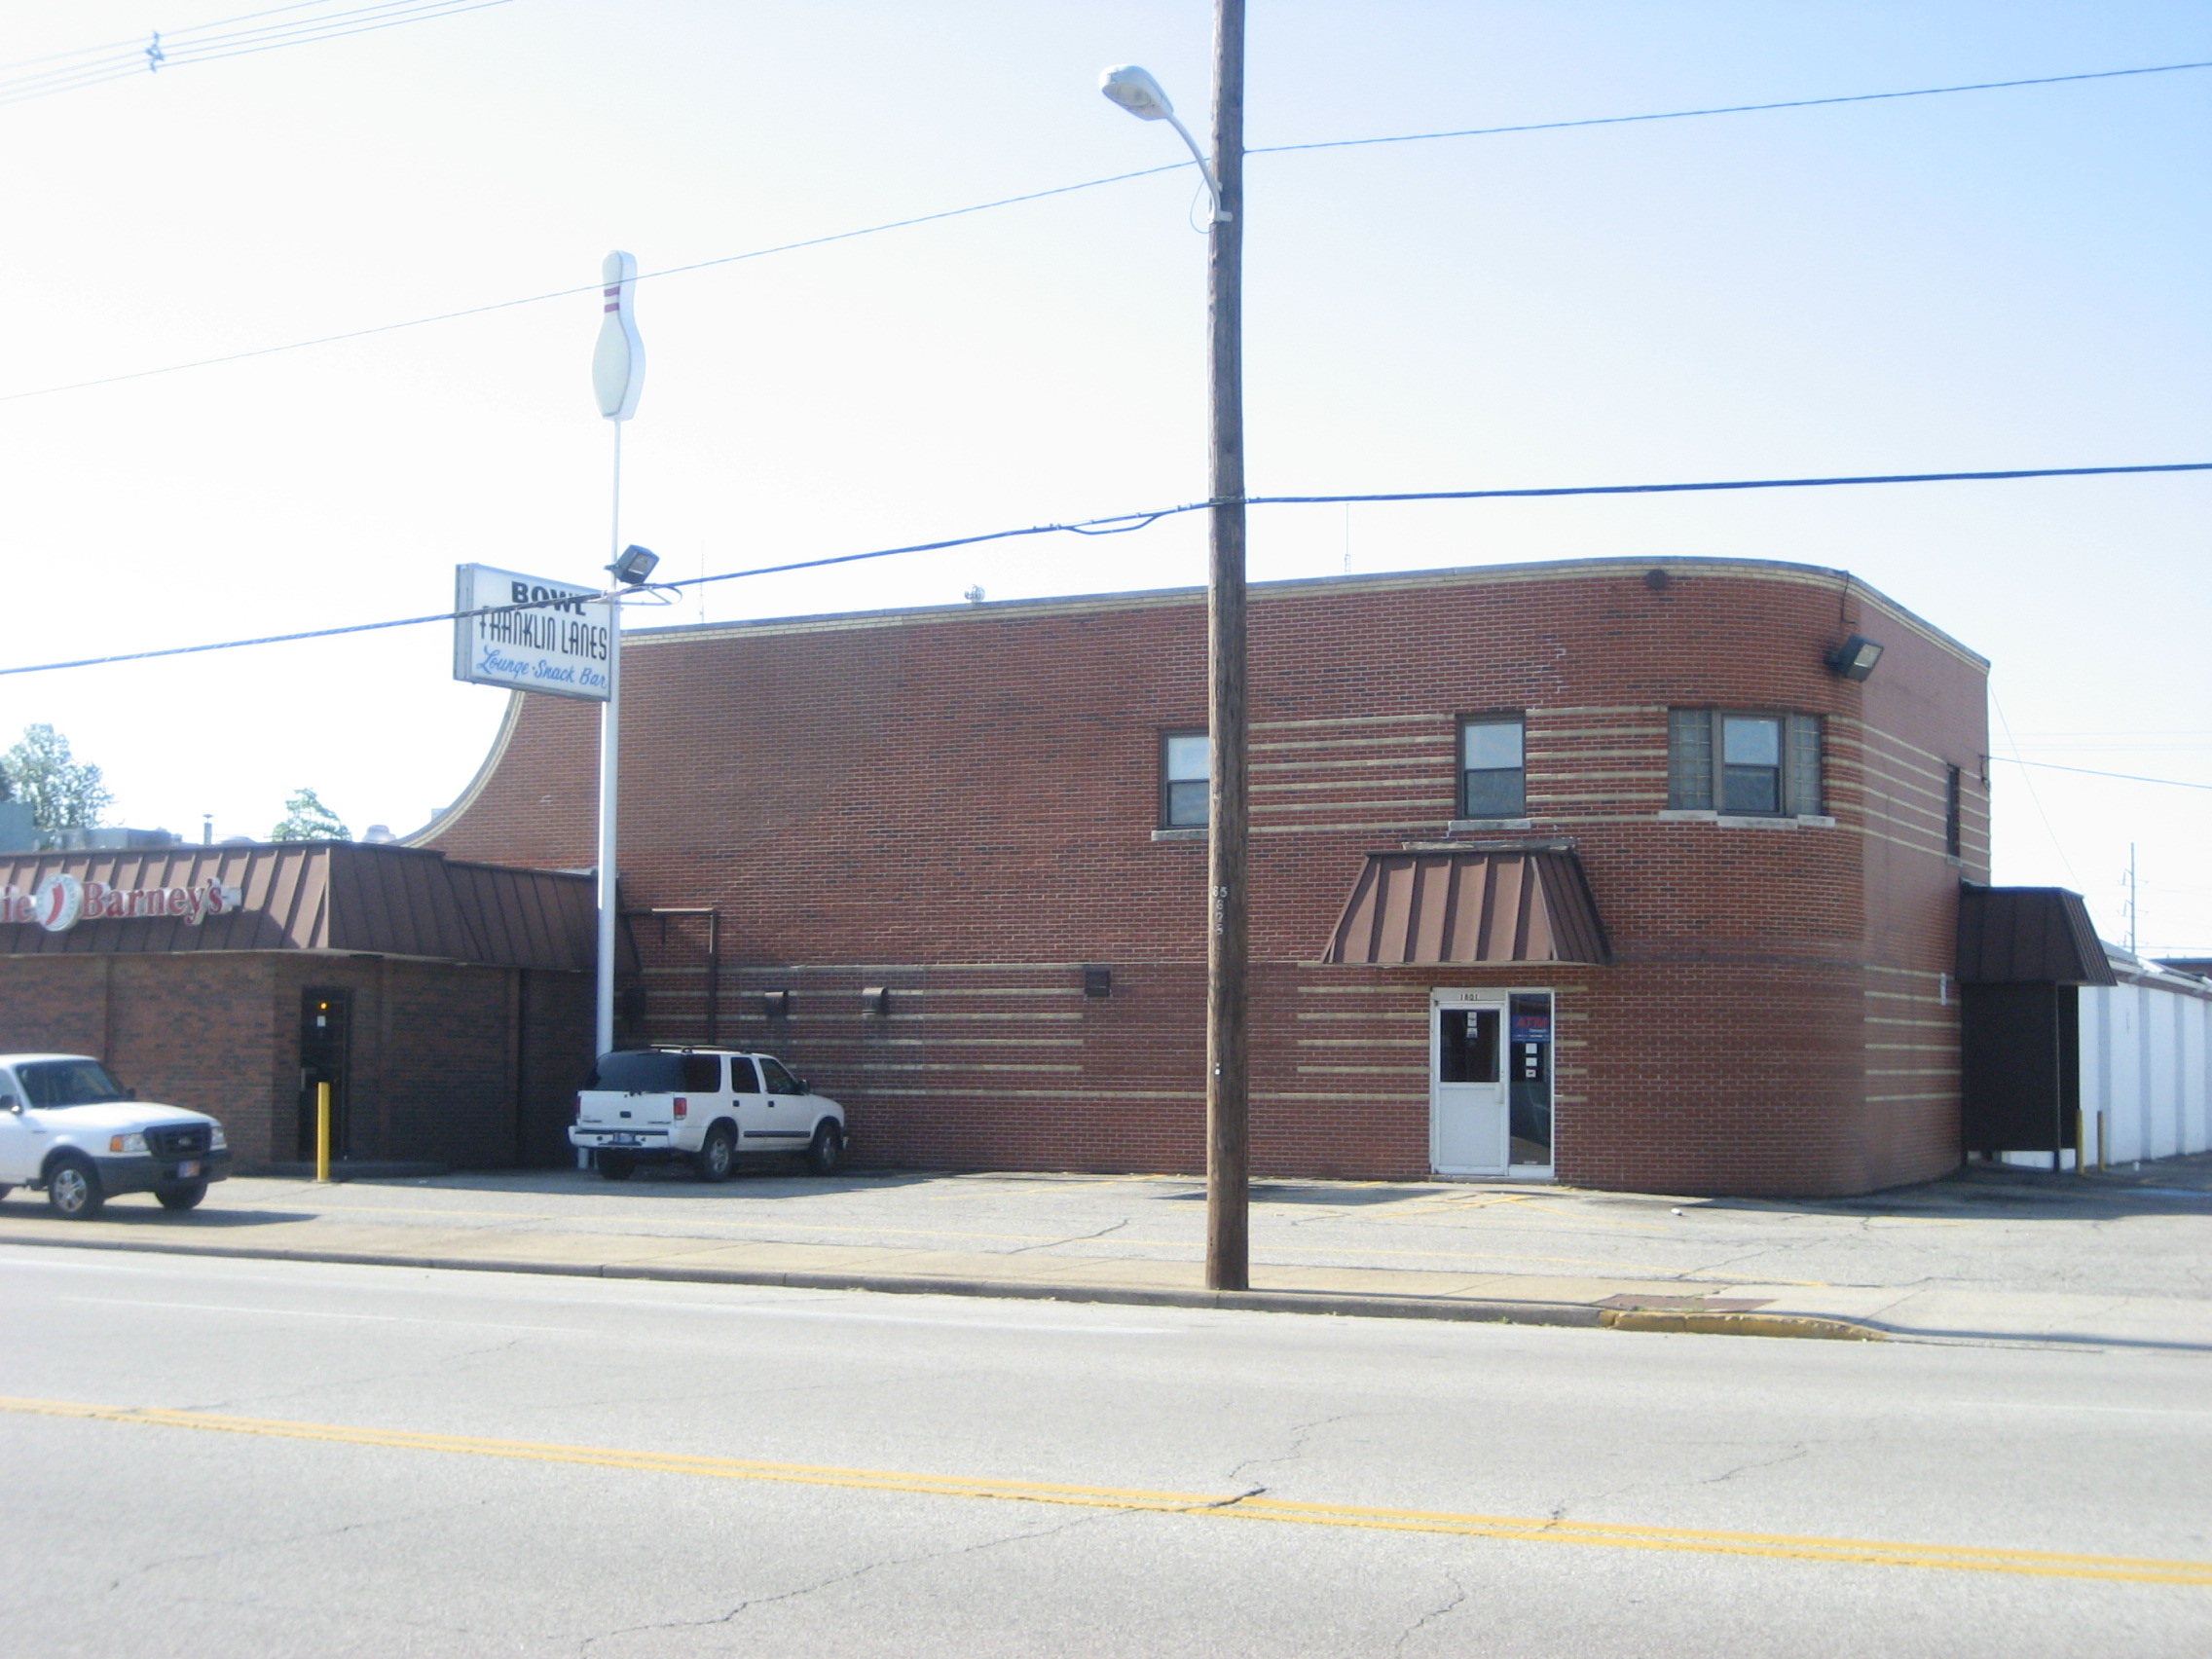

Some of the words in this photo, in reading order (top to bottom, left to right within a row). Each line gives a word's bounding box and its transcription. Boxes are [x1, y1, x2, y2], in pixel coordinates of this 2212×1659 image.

[512, 581, 586, 615] BOWL
[480, 607, 556, 651] FRANKLIN
[562, 620, 608, 660] LANES
[477, 645, 529, 680] Lounge
[535, 660, 575, 683] Snack
[579, 668, 607, 689] Bar
[83, 878, 222, 924] Barney's
[1516, 1016, 1549, 1028] ATM
